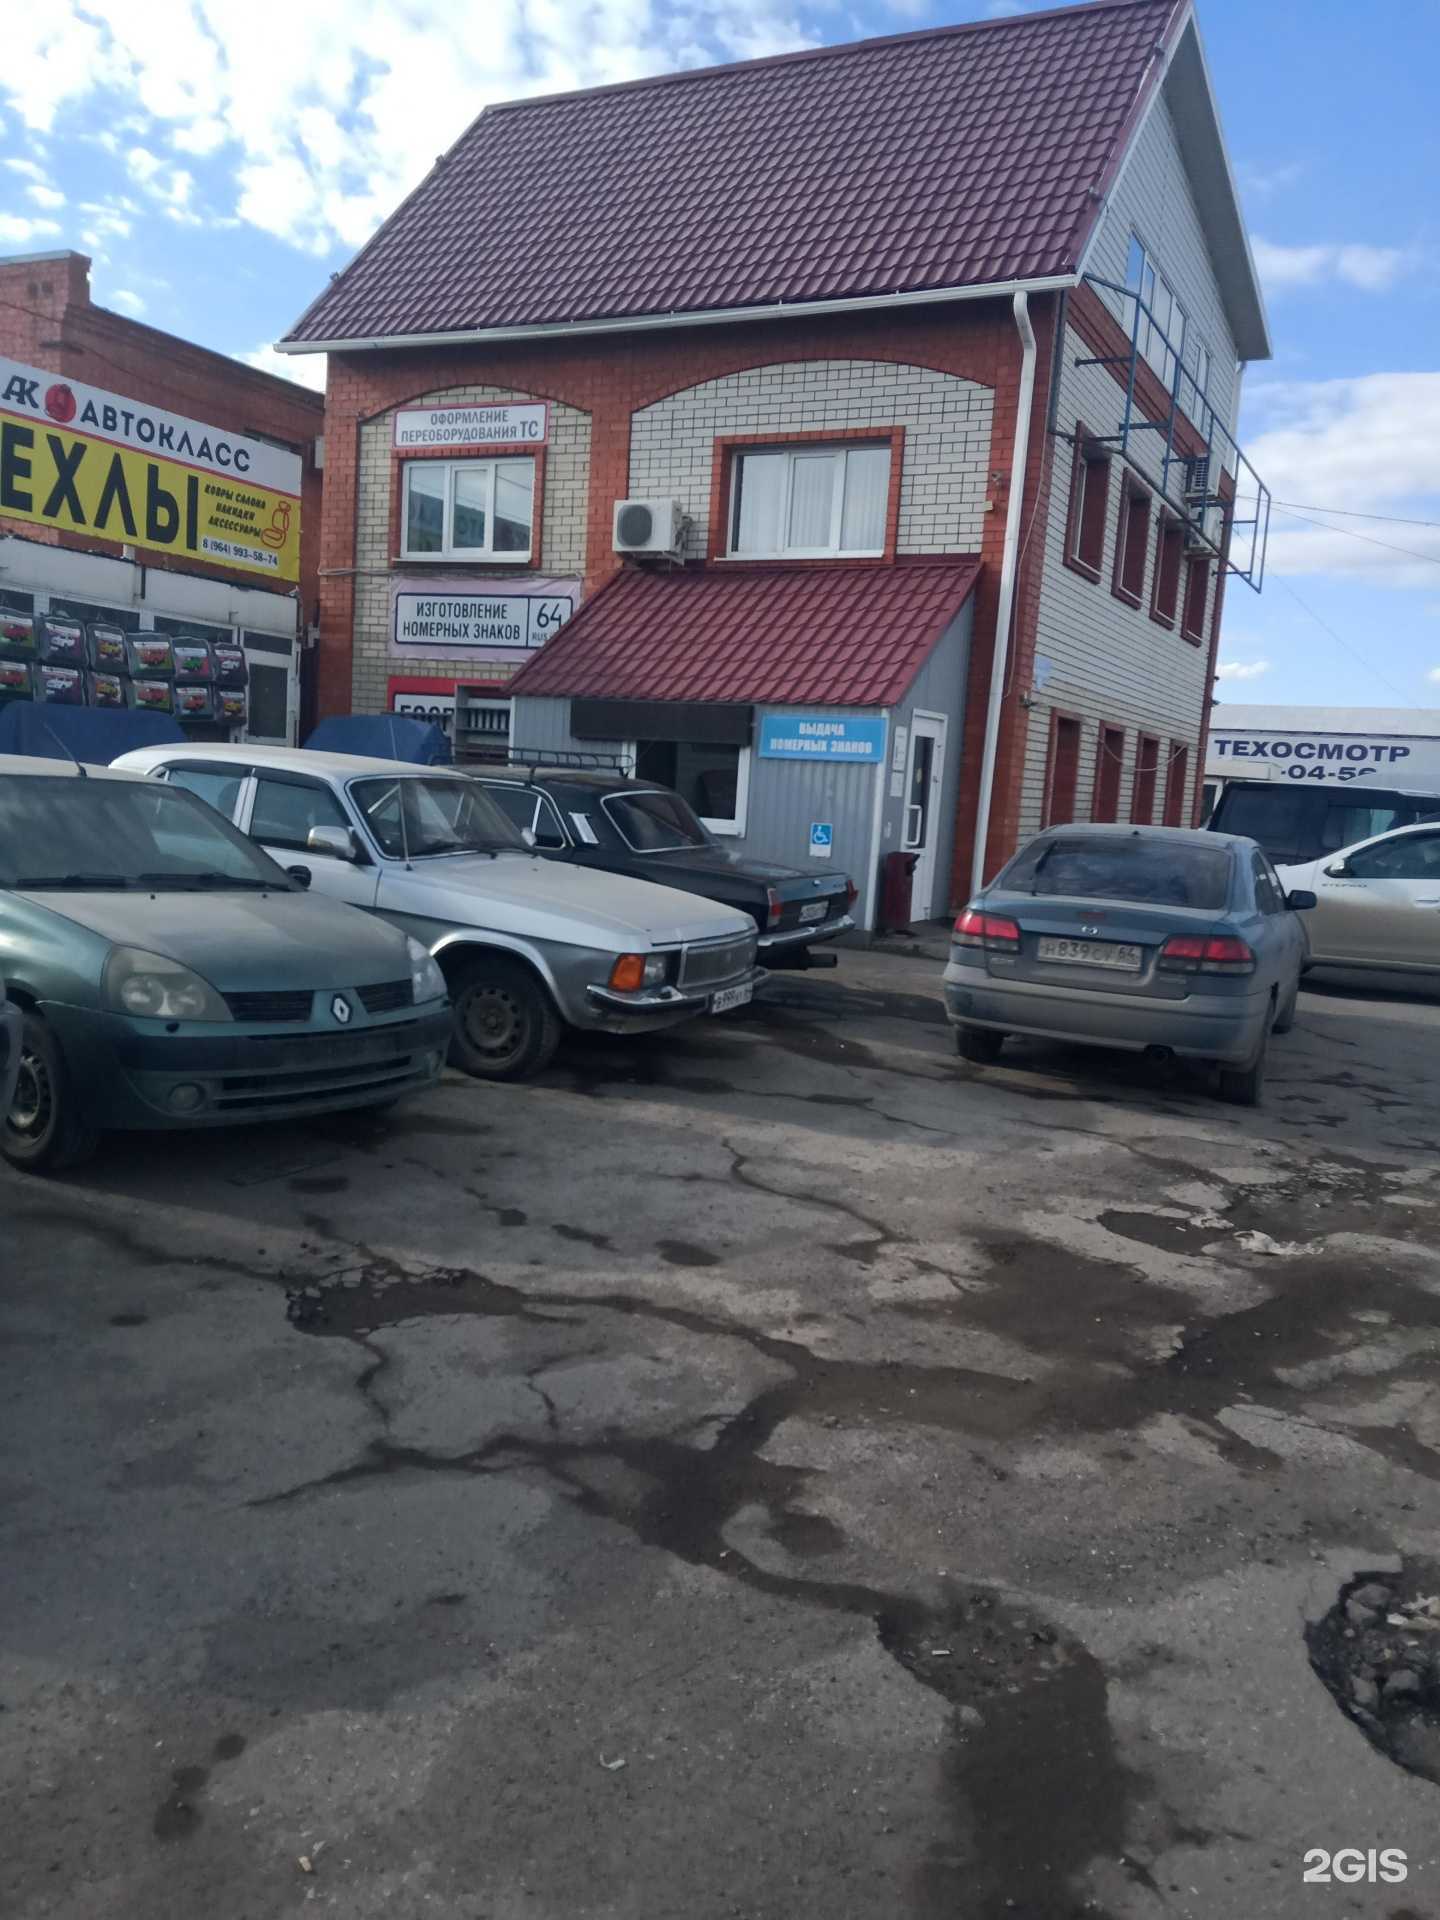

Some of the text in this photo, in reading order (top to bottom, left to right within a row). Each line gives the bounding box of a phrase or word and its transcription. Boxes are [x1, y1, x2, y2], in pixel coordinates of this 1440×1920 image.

[430, 409, 509, 426] ОФОРМЛЕНИЕ
[80, 399, 251, 473] АВТОКЛАСС
[401, 420, 539, 443] ПЕРЕОБОРУДОВАНИЯ ТС
[208, 515, 262, 538] АКСЕССУАРЫ
[416, 602, 561, 630] ИЗГОТОВЛЕНИЕ 64
[403, 621, 521, 640] НОМЕРНЫХ ЗНАКОВ
[799, 722, 845, 736] ВЫДАЧА
[769, 738, 828, 752] НОМЕРНЫХ
[1214, 739, 1411, 762] ТЕХОСМОТР
